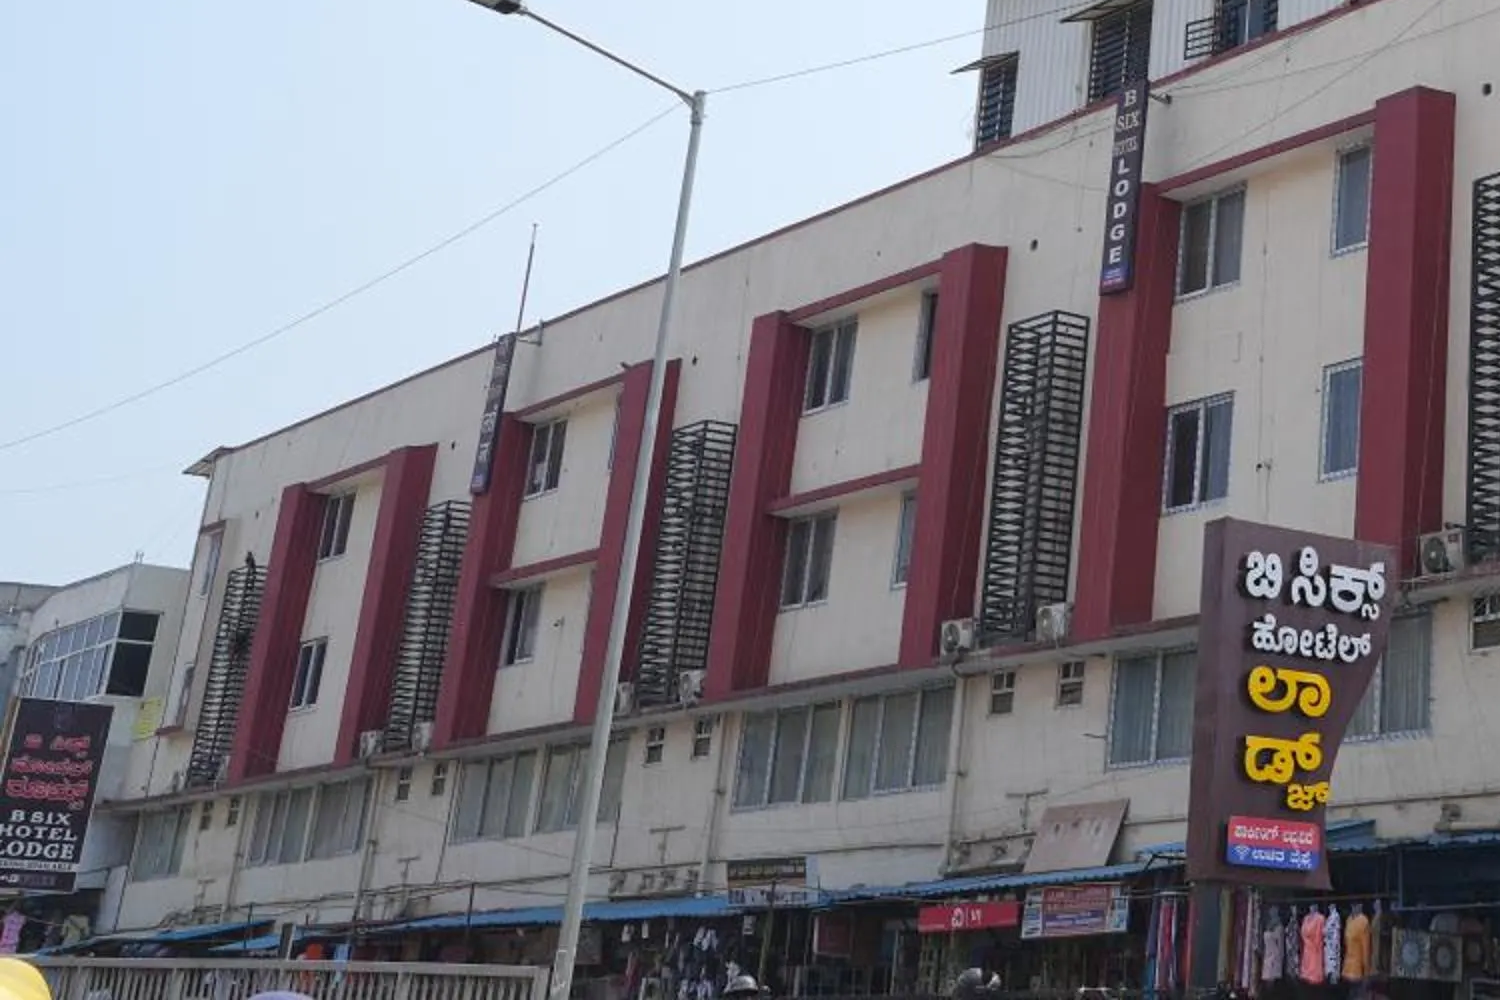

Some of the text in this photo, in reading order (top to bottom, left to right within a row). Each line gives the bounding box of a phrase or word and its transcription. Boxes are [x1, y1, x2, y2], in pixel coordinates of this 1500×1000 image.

[1109, 157, 1131, 265] LODGE
[1252, 613, 1371, 662] ಹೋಟೆಲ್
[0, 823, 77, 841] HOTEL
